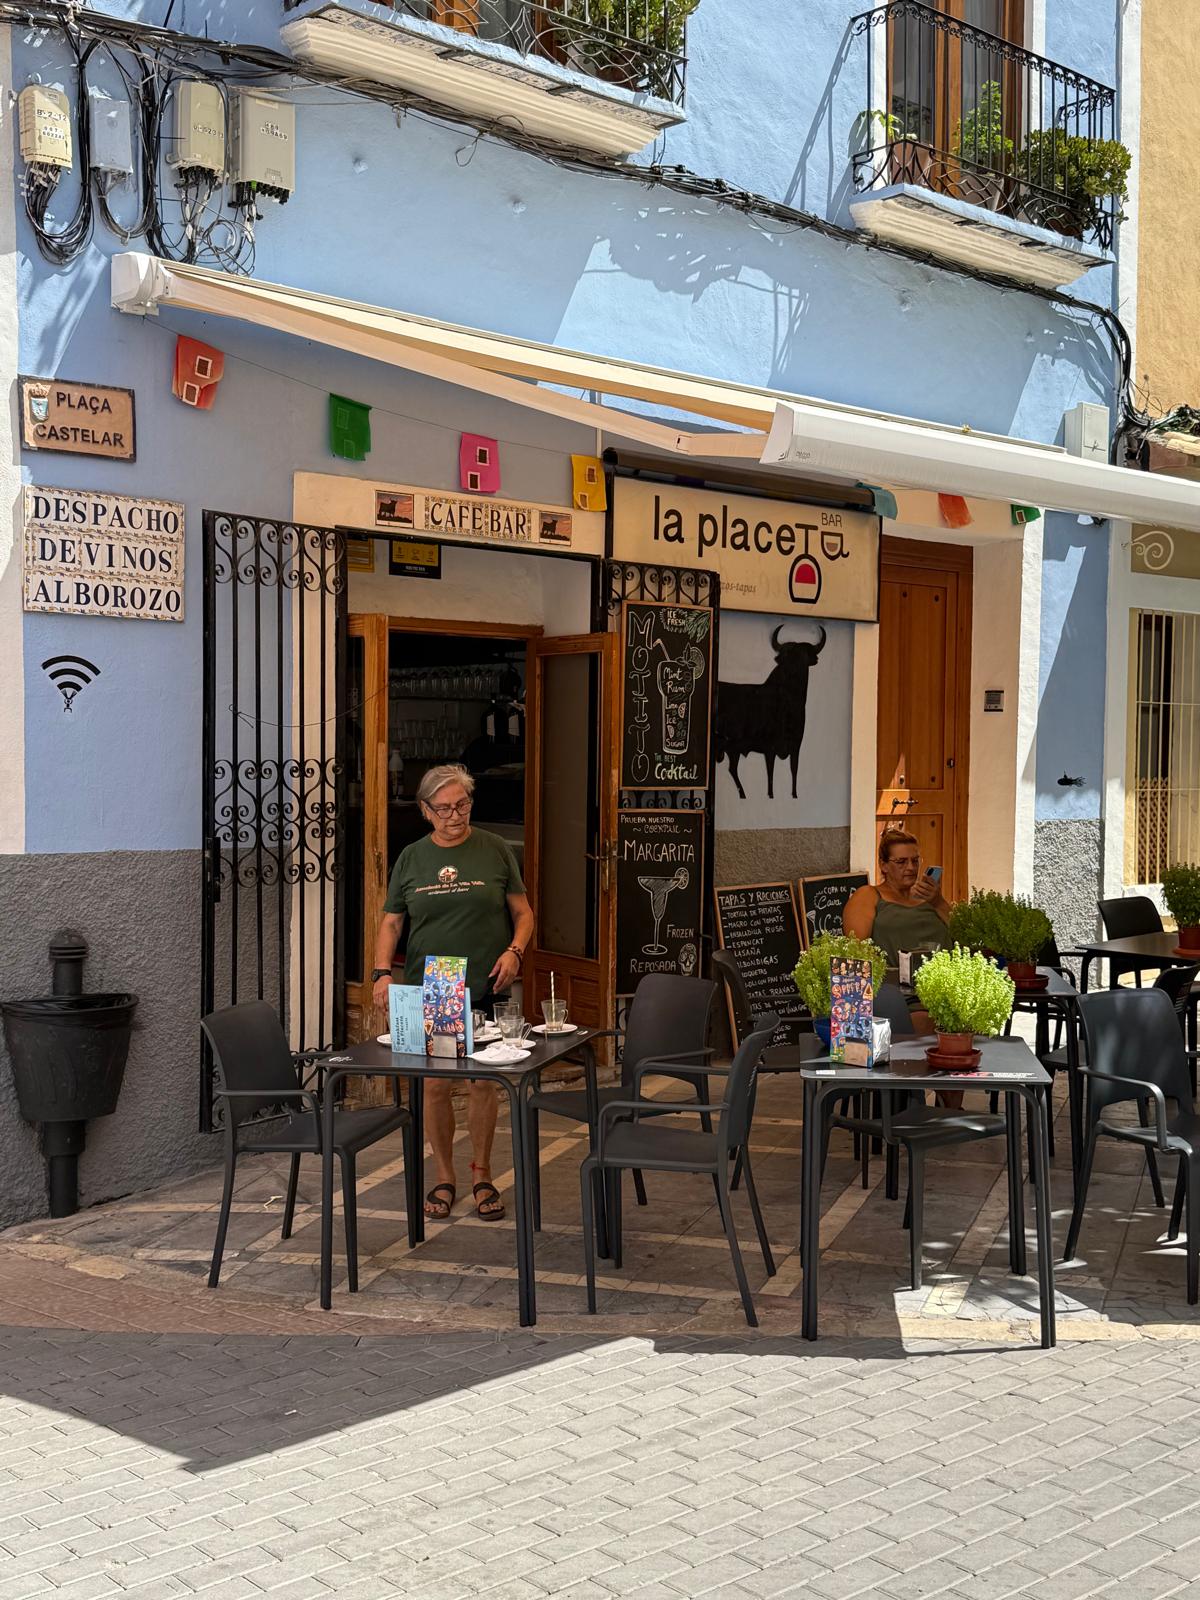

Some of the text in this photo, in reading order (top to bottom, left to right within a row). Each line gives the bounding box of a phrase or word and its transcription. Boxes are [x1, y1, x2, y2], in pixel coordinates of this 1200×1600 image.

[56, 391, 112, 414] PLAÇA
[36, 424, 124, 448] CASTELAR
[33, 495, 179, 535] DESPACHO
[430, 502, 526, 535] CAFE BAR
[653, 495, 685, 543] la
[821, 512, 842, 527] BAR
[38, 537, 172, 573] DE VINOS
[33, 579, 181, 613] ALBOROZO
[667, 610, 677, 619] ICE
[667, 619, 686, 627] FRESH
[663, 667, 683, 681] Mint
[665, 680, 686, 694] Rum
[624, 839, 695, 863] MARGARITA
[719, 890, 789, 906] TAPAS Y RACIONES
